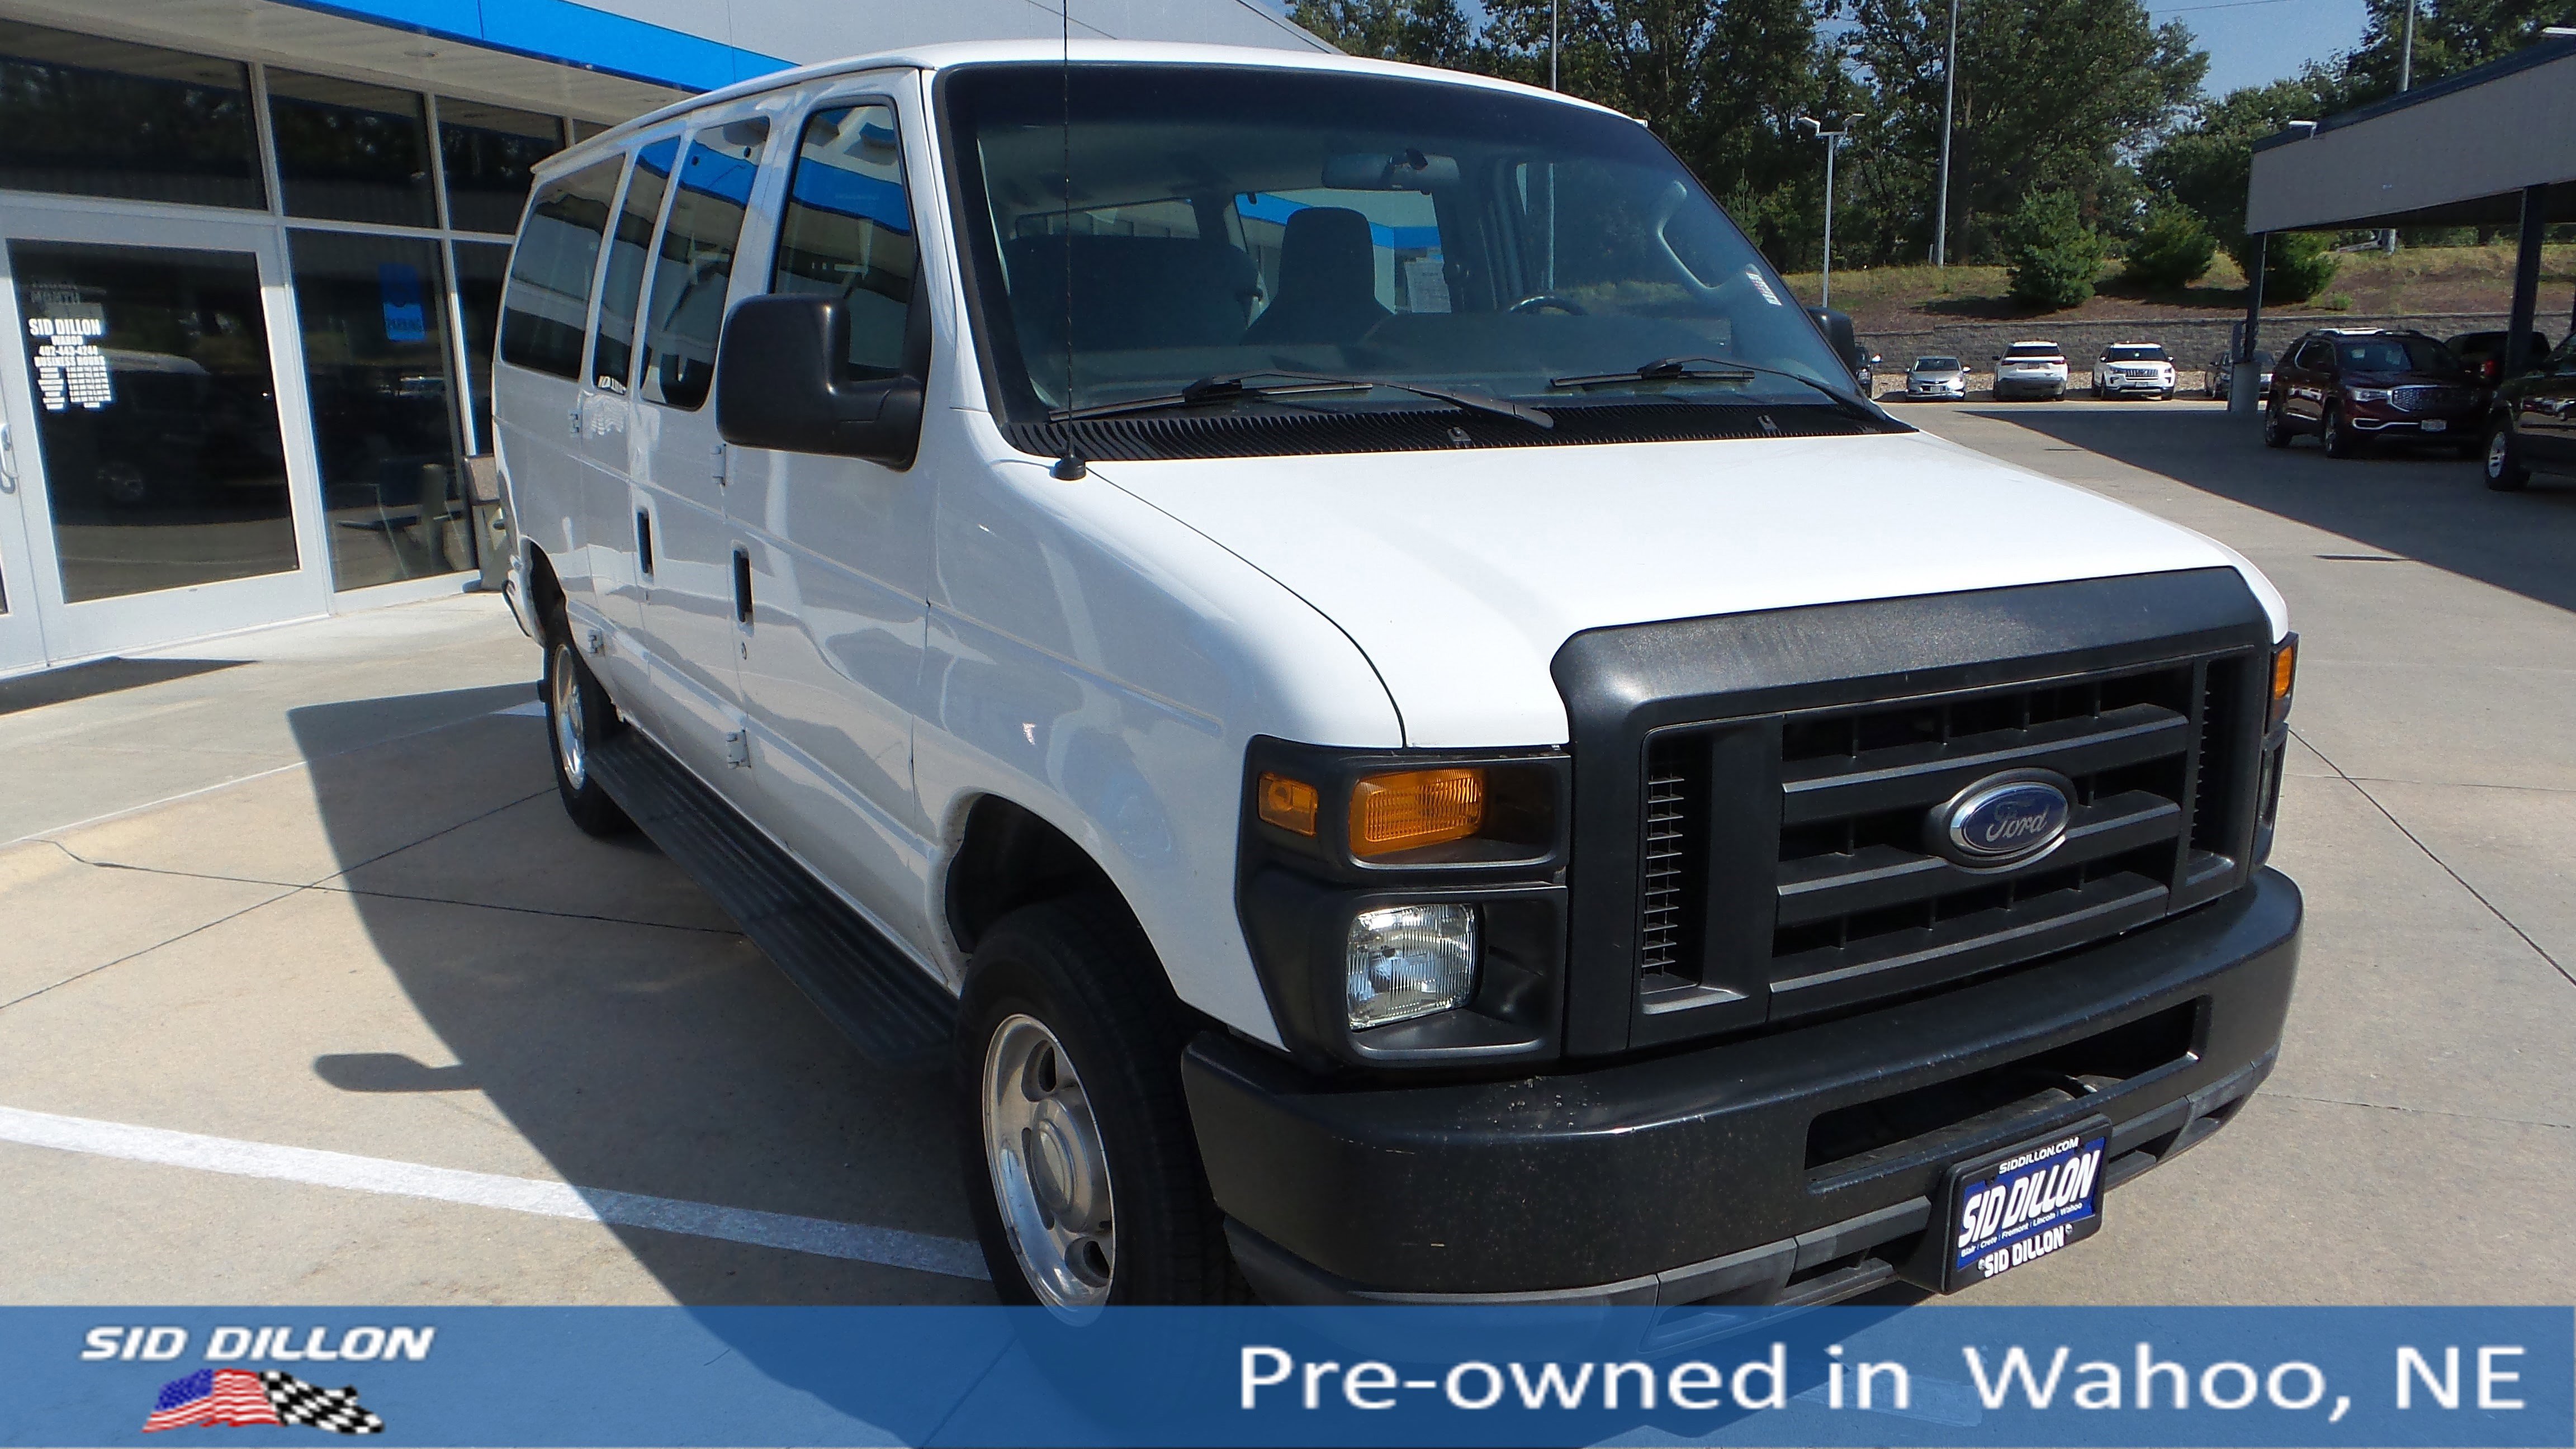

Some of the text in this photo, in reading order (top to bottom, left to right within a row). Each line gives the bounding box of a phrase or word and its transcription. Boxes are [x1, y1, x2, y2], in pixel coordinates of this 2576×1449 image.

[29, 319, 102, 335] SID DILLON
[1986, 801, 2051, 842] Ford
[1999, 1137, 2079, 1175] SIDDILLON.COM
[1958, 1149, 2101, 1248] SID DILLON
[2001, 1223, 2029, 1239] Fremont
[2033, 1212, 2056, 1227] Lincoln
[2060, 1202, 2082, 1216] Wahoo
[1984, 1225, 2064, 1278] SID DILLON
